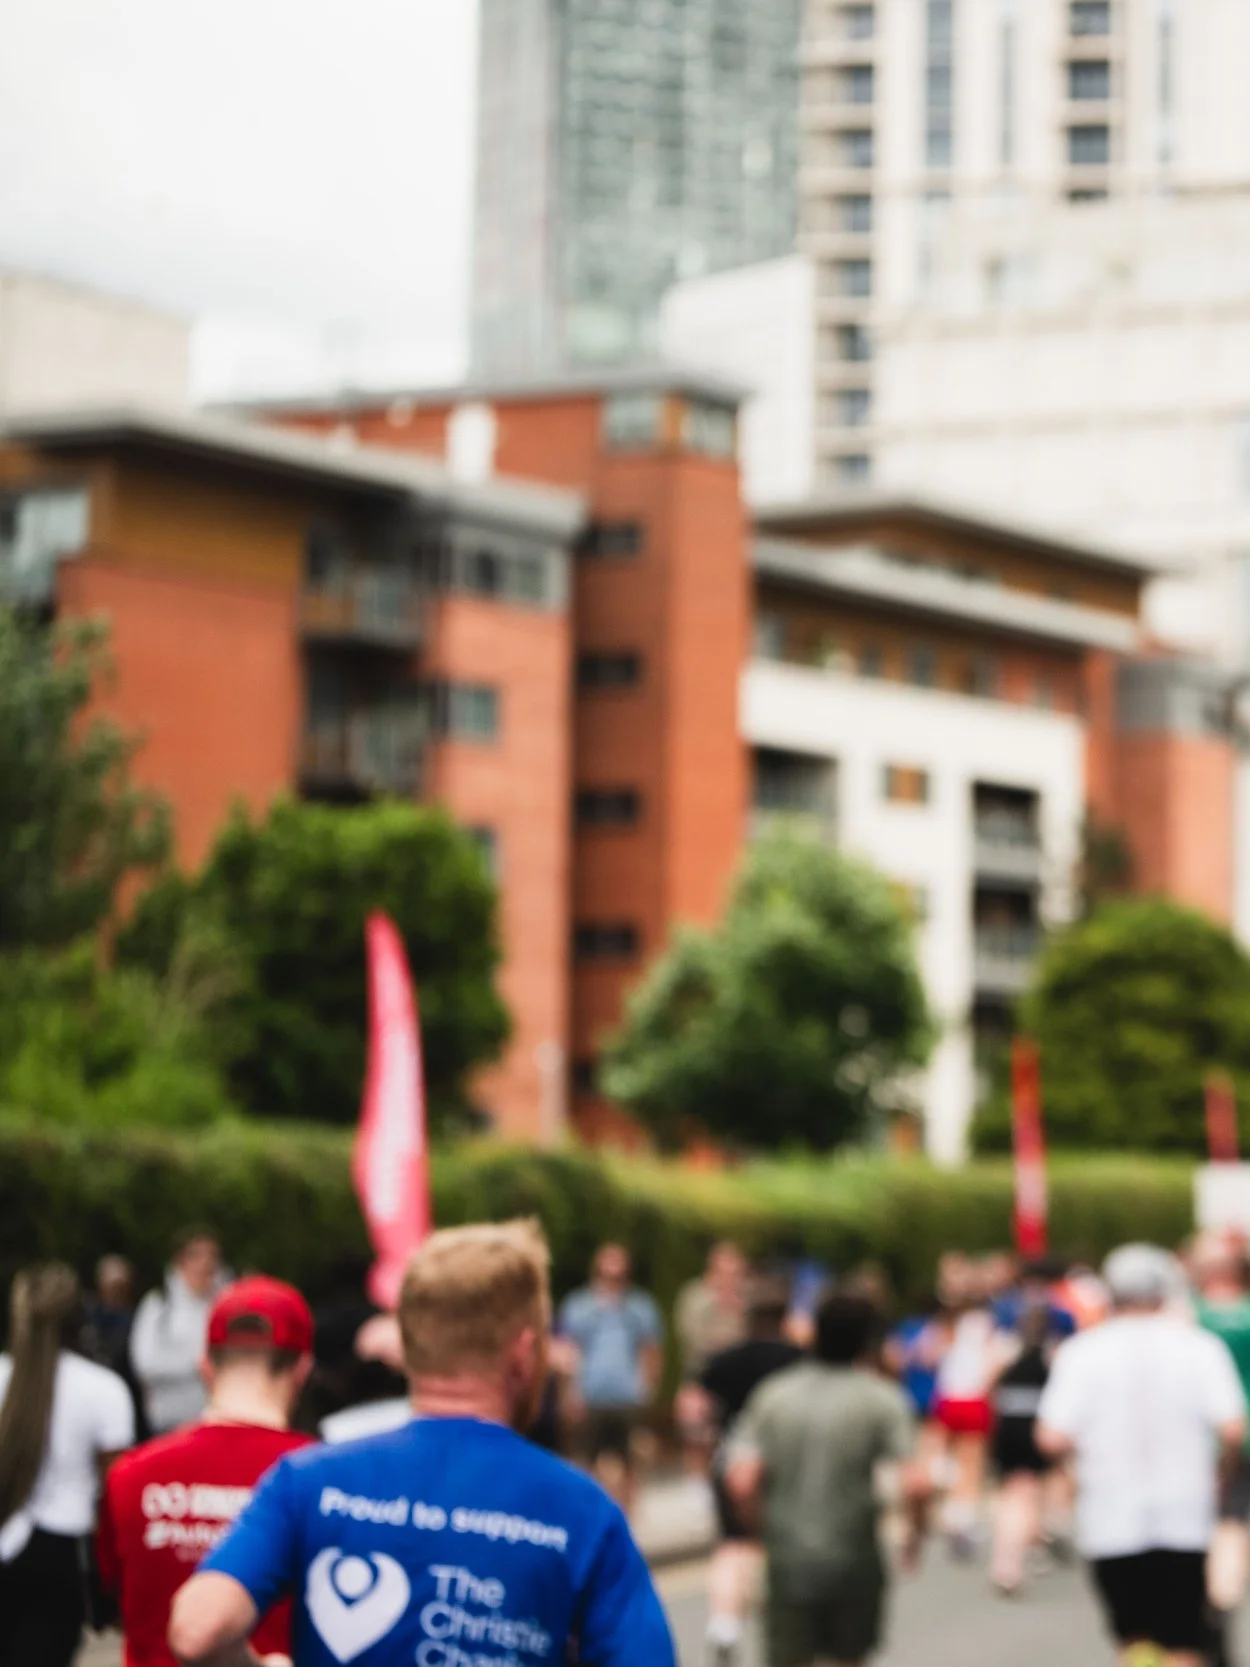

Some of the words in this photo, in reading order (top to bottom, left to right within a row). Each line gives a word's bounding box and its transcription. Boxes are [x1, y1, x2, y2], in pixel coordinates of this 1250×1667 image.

[320, 1487, 410, 1527] Proud
[412, 1501, 448, 1531] to
[450, 1506, 569, 1552] support
[429, 1564, 506, 1608] The
[420, 1600, 551, 1656] Christie
